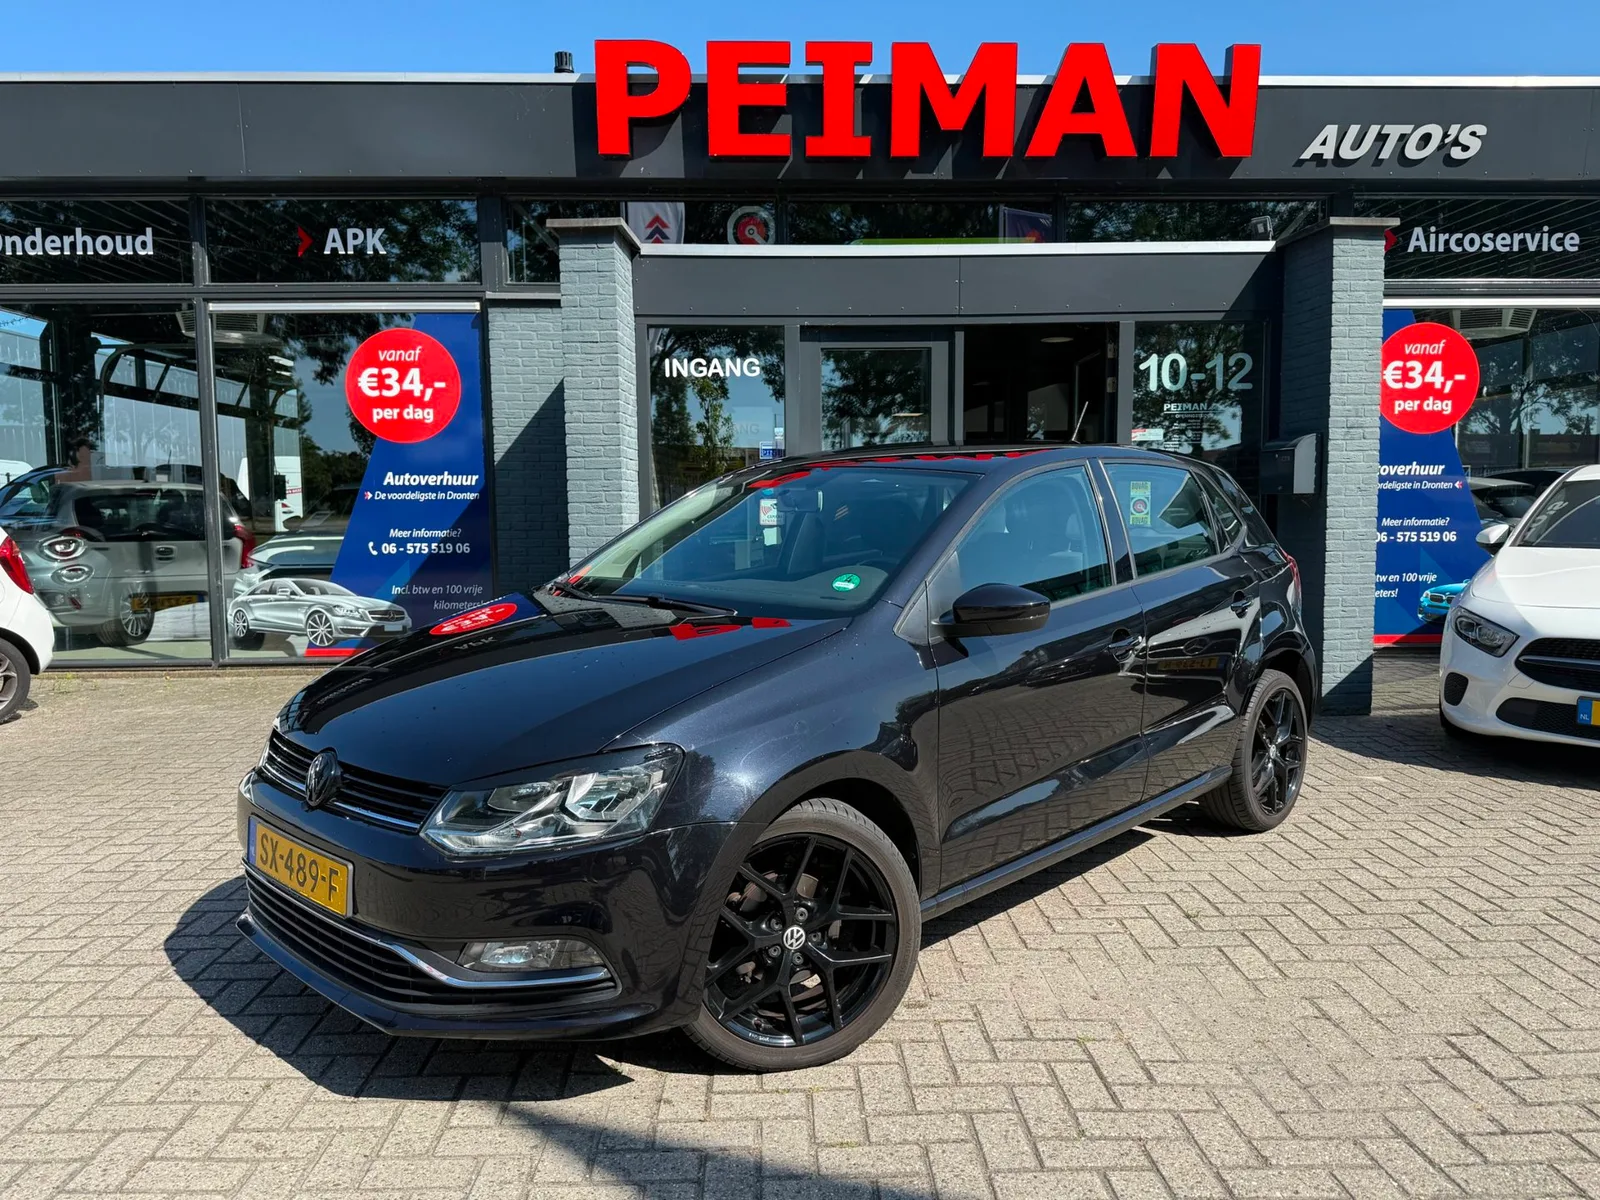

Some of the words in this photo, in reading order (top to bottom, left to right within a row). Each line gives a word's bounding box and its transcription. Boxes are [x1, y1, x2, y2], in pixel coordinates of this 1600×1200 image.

[594, 39, 1262, 158] PEIMAN
[1300, 123, 1488, 160] AUTO'S
[0, 227, 154, 256] nderhoud
[323, 228, 387, 255] APK
[1407, 226, 1580, 253] Aircoservice
[378, 345, 422, 362] vanaf
[1404, 339, 1447, 355] vanaf
[664, 358, 761, 378] INGANG
[1139, 352, 1254, 392] 10-12
[1382, 360, 1466, 394] €34,-
[357, 367, 446, 402] €34,-
[372, 407, 400, 423] per
[403, 404, 434, 423] dag
[1163, 402, 1208, 411] PEIMAN
[1394, 400, 1419, 415] per
[1423, 396, 1452, 415] dag
[383, 471, 479, 486] Autoverhuur
[1413, 481, 1420, 489] in
[1421, 481, 1453, 489] Dronten
[374, 491, 386, 500] De
[387, 491, 435, 502] voordeligste
[437, 491, 446, 500] in
[446, 491, 480, 500] Dronten
[1381, 518, 1402, 527] Meer
[1403, 517, 1450, 527] informatie?
[389, 528, 412, 538] Meer
[412, 528, 462, 538] informatie?
[1396, 531, 1417, 542] 575
[1419, 531, 1440, 542] 519
[1442, 531, 1457, 542] 06
[381, 542, 397, 554] 06
[406, 542, 429, 554] 575
[431, 542, 453, 554] 519
[455, 542, 471, 554] 06
[1388, 574, 1400, 582] en
[1402, 572, 1418, 582] 100
[1418, 572, 1438, 584] vrije
[391, 585, 410, 594] Incl.
[412, 585, 430, 594] btw
[431, 586, 443, 594] en
[445, 585, 462, 594] 100
[463, 584, 483, 596] vrije
[259, 832, 340, 903] SX-489-F
